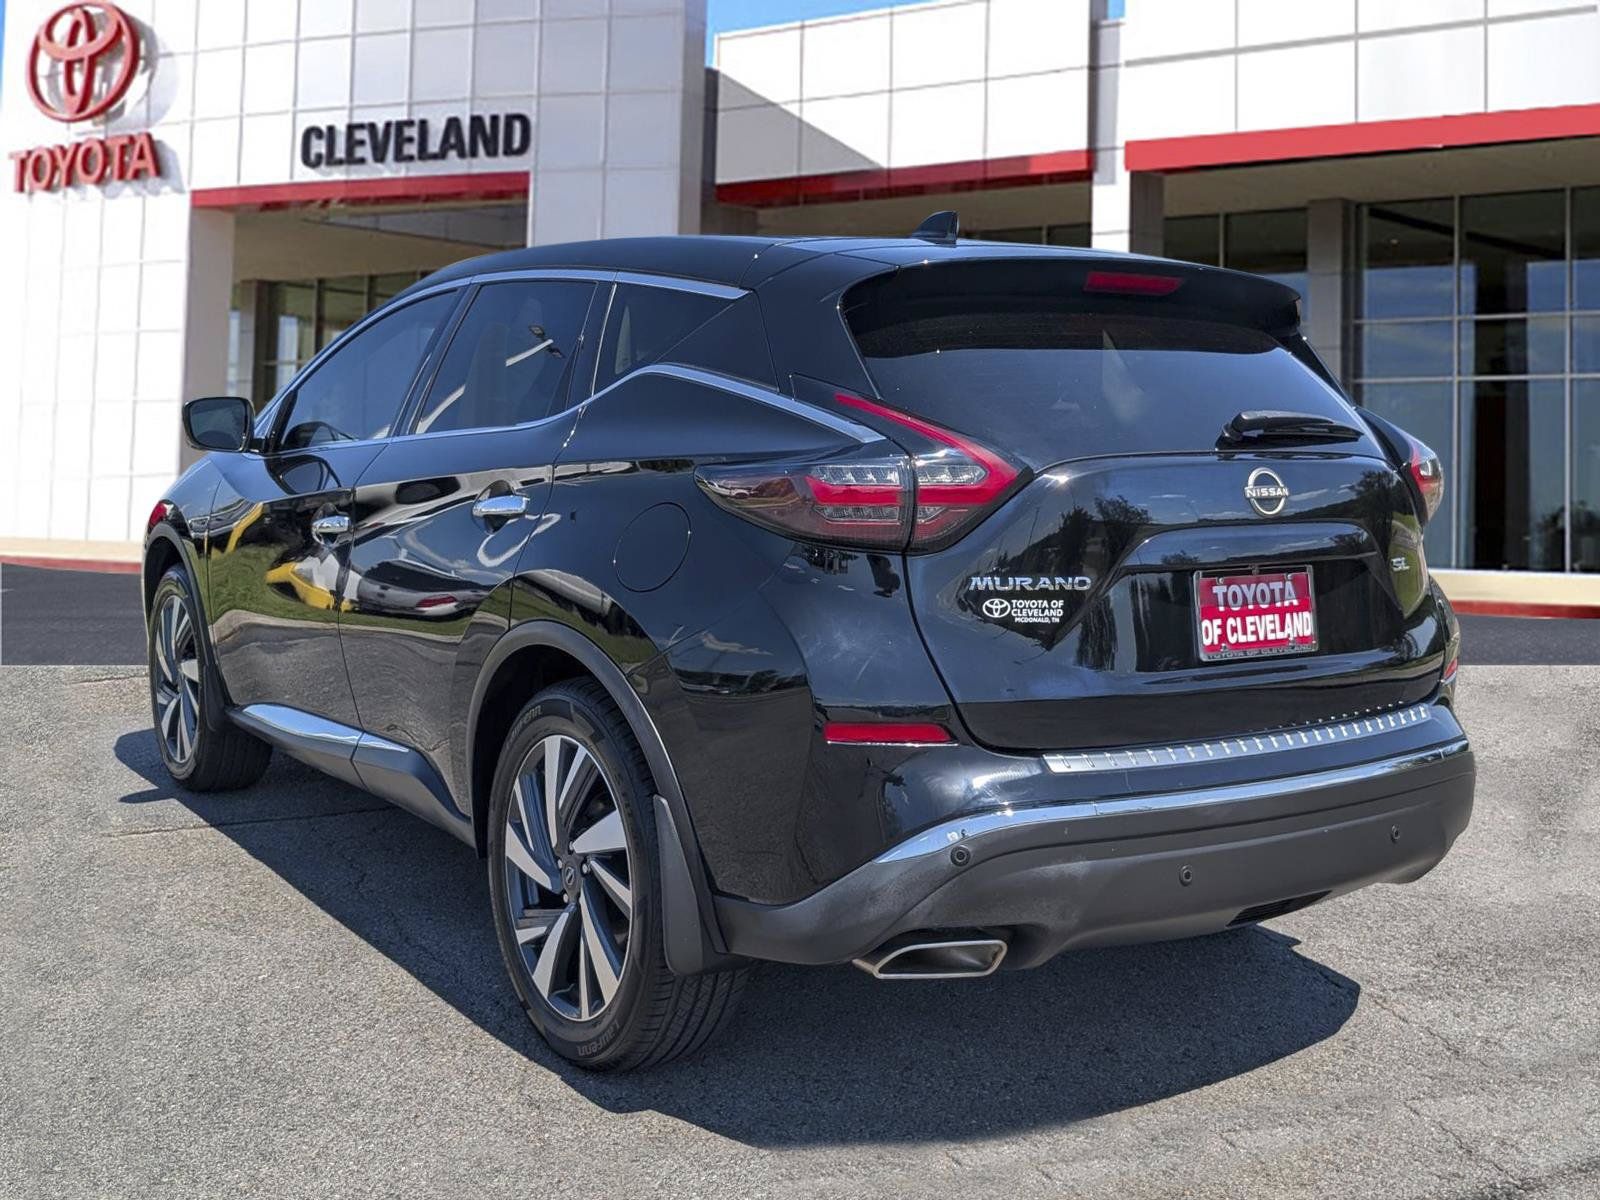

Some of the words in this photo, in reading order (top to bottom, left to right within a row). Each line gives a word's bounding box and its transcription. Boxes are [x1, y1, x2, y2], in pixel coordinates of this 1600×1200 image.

[300, 112, 532, 170] CLEVELAND
[9, 132, 162, 193] TOYOTA
[1246, 487, 1289, 498] NISSAN
[1391, 556, 1410, 571] SL
[968, 576, 1093, 591] MURANO
[1212, 581, 1299, 612] TOYOTA
[1011, 600, 1049, 609] TOYOTA
[1050, 600, 1065, 608] OF
[1011, 608, 1064, 617] CLEVELAND
[1201, 618, 1223, 646] OF
[1226, 611, 1313, 645] CLEVELAND
